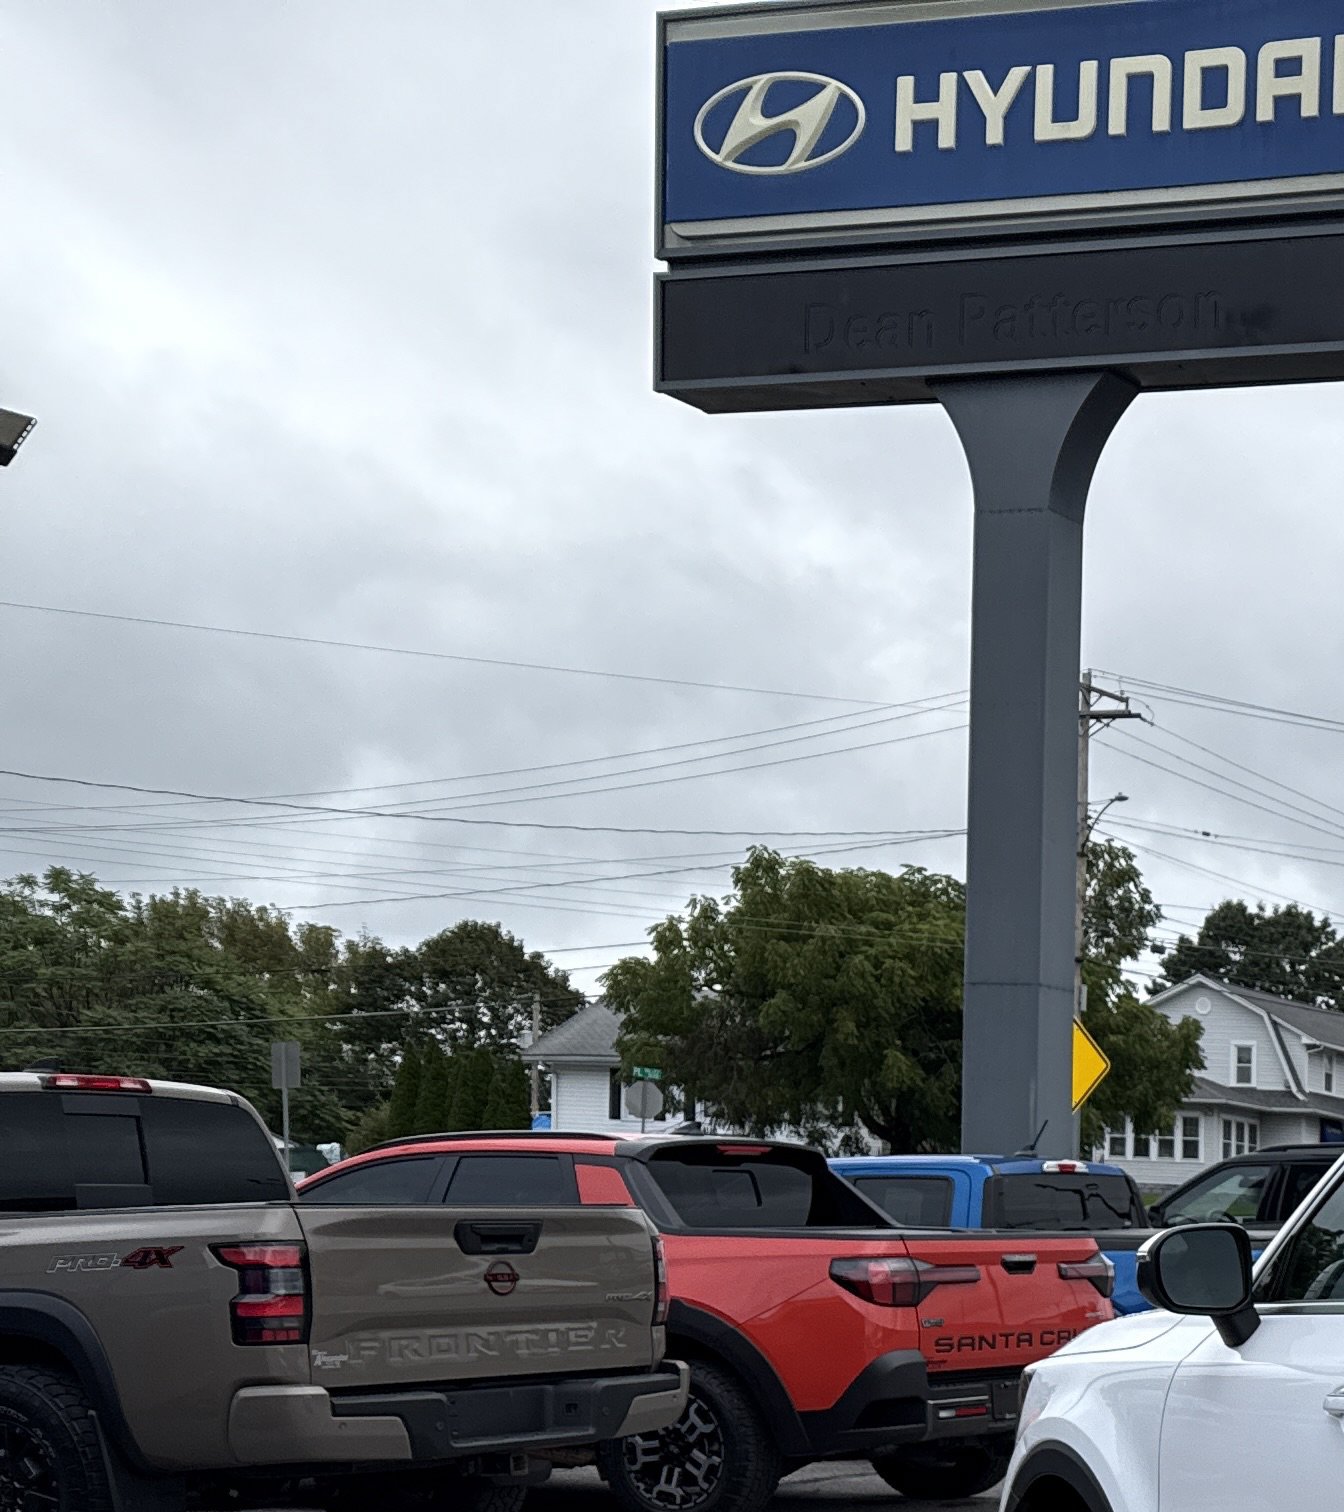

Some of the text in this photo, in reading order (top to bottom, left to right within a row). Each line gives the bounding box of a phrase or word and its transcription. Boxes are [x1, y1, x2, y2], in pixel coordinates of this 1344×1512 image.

[802, 289, 1225, 355] Dean Patterson
[346, 1325, 628, 1368] FRONTIER
[934, 1332, 1034, 1354] SANTA
